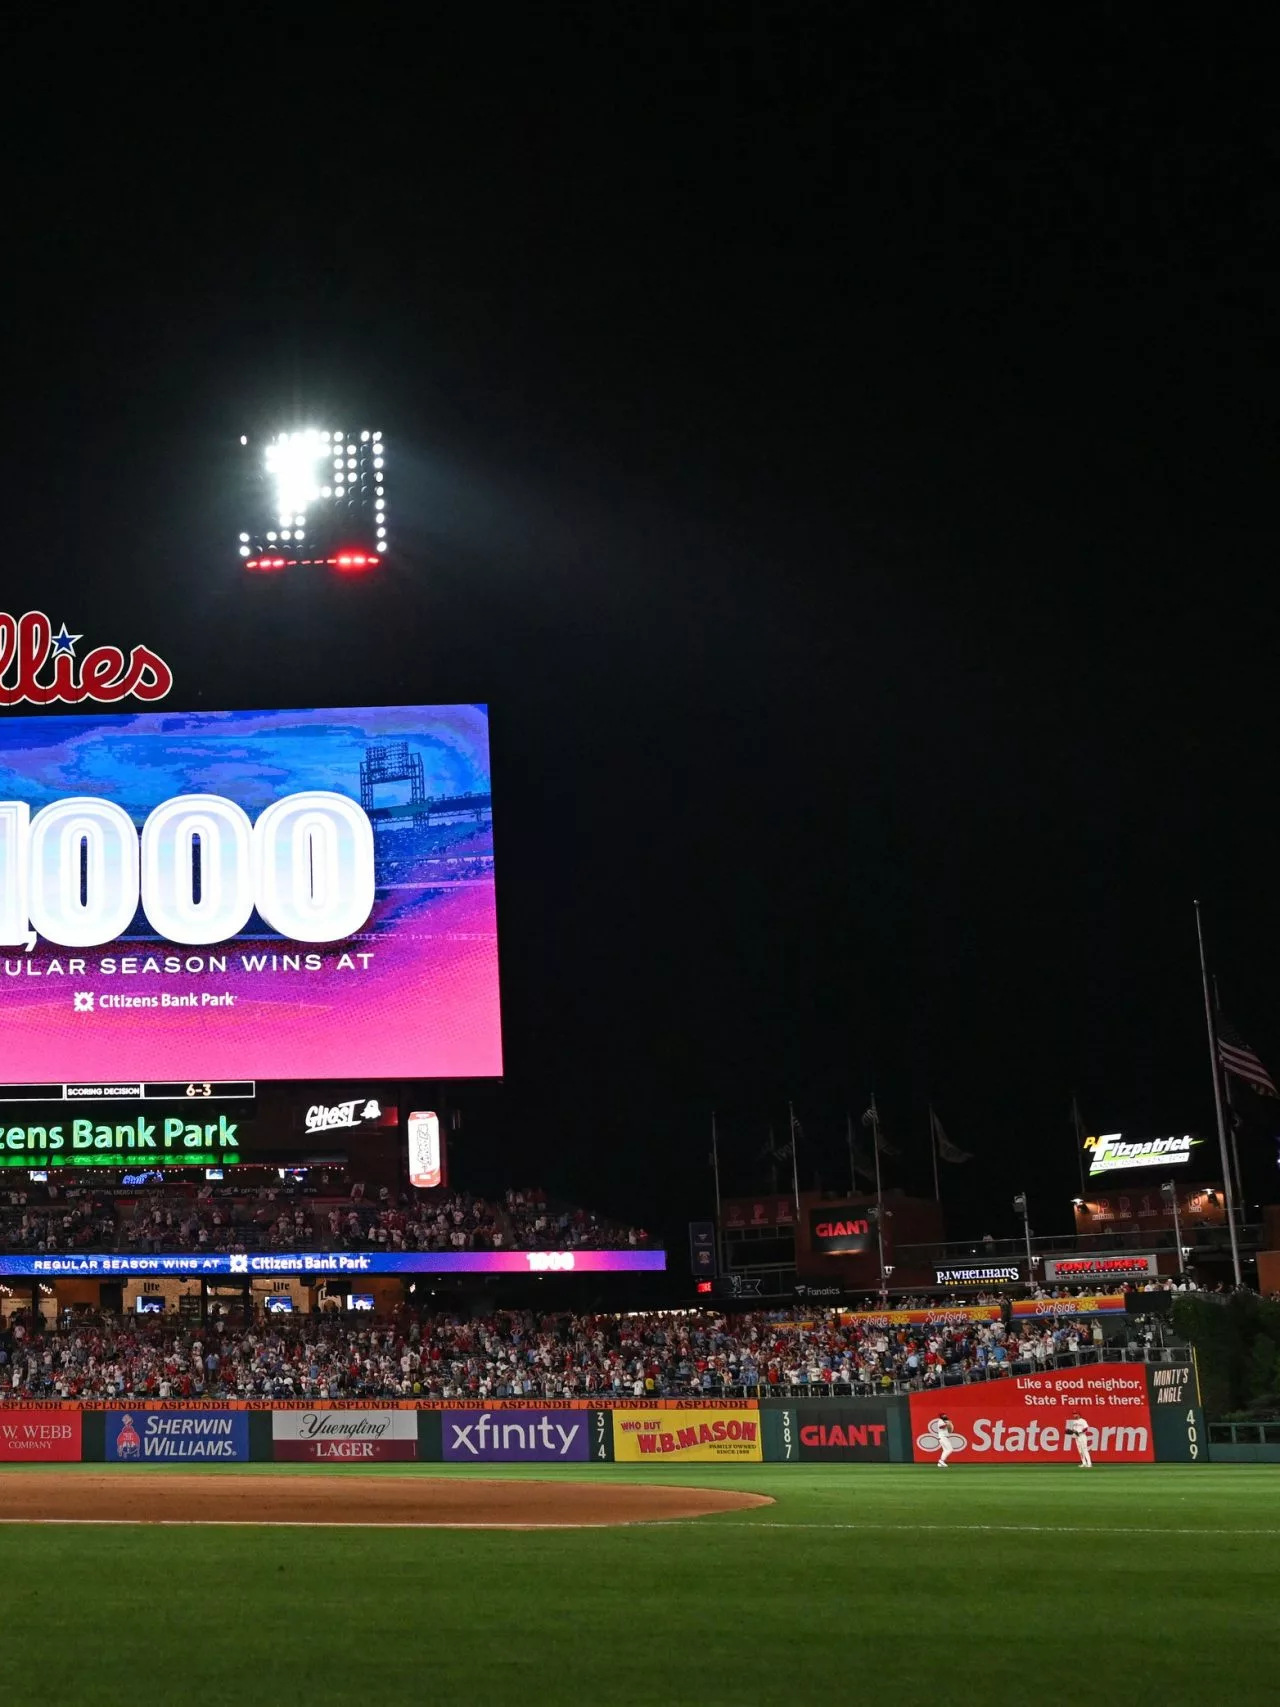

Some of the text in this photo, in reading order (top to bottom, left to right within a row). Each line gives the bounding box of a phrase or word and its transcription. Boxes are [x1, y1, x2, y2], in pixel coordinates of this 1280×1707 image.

[99, 956, 227, 975] SEASON
[241, 954, 322, 972] WINS
[336, 953, 375, 970] AT
[99, 992, 234, 1008] Citizens Bank Park
[67, 1086, 140, 1096] SCORING DECISION
[186, 1083, 212, 1097] 6-3
[305, 1099, 366, 1132] GHOST
[72, 1116, 157, 1149] Bank
[163, 1115, 239, 1148] Park
[816, 1219, 869, 1237] GIANT
[34, 1259, 220, 1269] REGULAR SEASON WINS AT
[251, 1255, 368, 1269] Citizens Bank Park
[1055, 1258, 1148, 1271] TONY LUKE'S
[807, 1287, 841, 1296] Fanatics
[1036, 1301, 1076, 1315] Surfside
[927, 1310, 967, 1323] Surfside
[1153, 1367, 1189, 1386] MONTY'S
[1017, 1377, 1142, 1391] Like a good neighbor,
[1024, 1394, 1144, 1406] State Farm is there.
[1157, 1385, 1182, 1404] ANGLE
[76, 1401, 146, 1410] ASPLUNDH
[160, 1401, 231, 1410] ASPLUNDH
[245, 1401, 315, 1410] ASPLUNDH
[329, 1401, 400, 1410] ASPLUNDH
[415, 1401, 485, 1410] ASPLUNDH
[500, 1401, 571, 1410] ASPLUNDH
[586, 1401, 659, 1410] ASPLUNDH
[675, 1401, 748, 1410] ASPLUNDH
[23, 1425, 72, 1439] WEBB
[145, 1415, 232, 1435] SHERWIN
[299, 1413, 392, 1439] Yuengling
[621, 1421, 661, 1431] WHO BUT
[451, 1413, 580, 1455] xfinity
[799, 1424, 886, 1446] GIANT
[8, 1441, 53, 1449] COMPANY
[144, 1437, 233, 1456] WILLIAMS
[316, 1442, 375, 1457] LAGER
